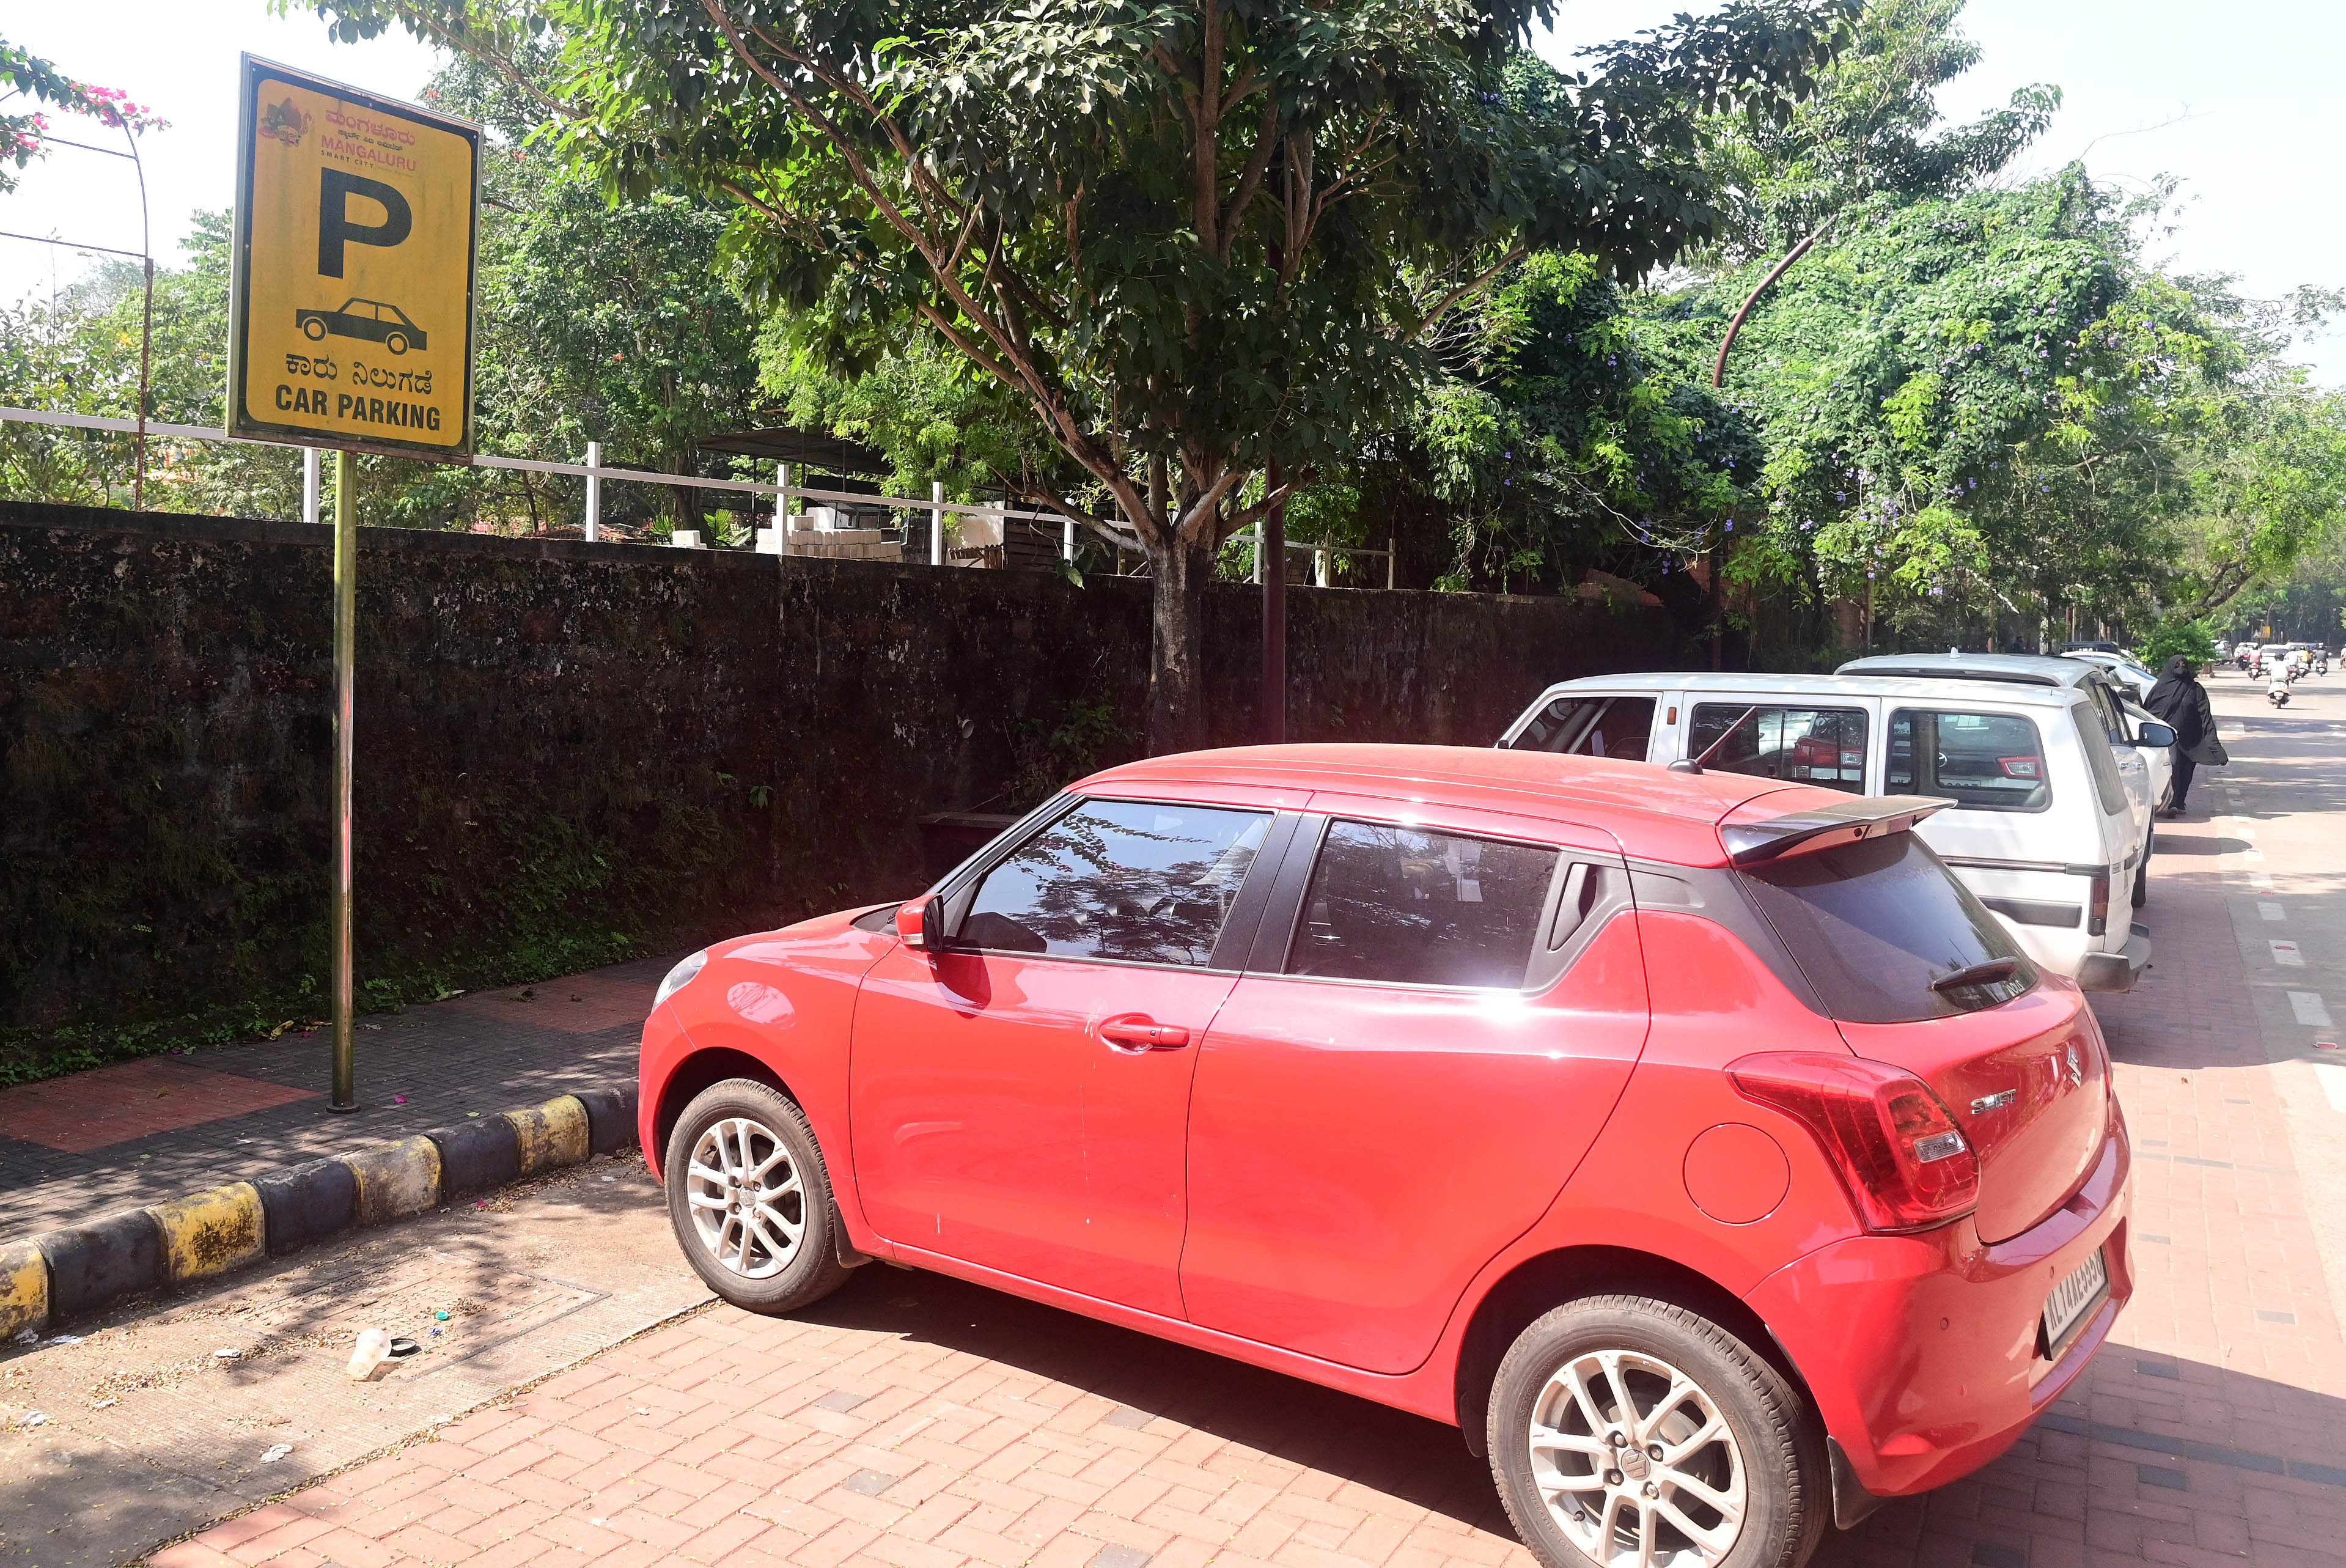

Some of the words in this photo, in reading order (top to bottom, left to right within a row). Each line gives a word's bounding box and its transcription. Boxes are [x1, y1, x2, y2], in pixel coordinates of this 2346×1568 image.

[326, 110, 416, 146] ಮಂಗಳೂರು
[321, 134, 416, 172] MANGALURU
[321, 150, 350, 162] SMART
[355, 158, 374, 169] CITY
[318, 166, 413, 279] P
[286, 353, 337, 380] ಕಾರು
[353, 361, 432, 395] ನಿಲುಗಡೆ
[275, 384, 328, 416] CAR
[337, 393, 440, 431] PARKING
[1971, 1088, 2017, 1114] SWIFT
